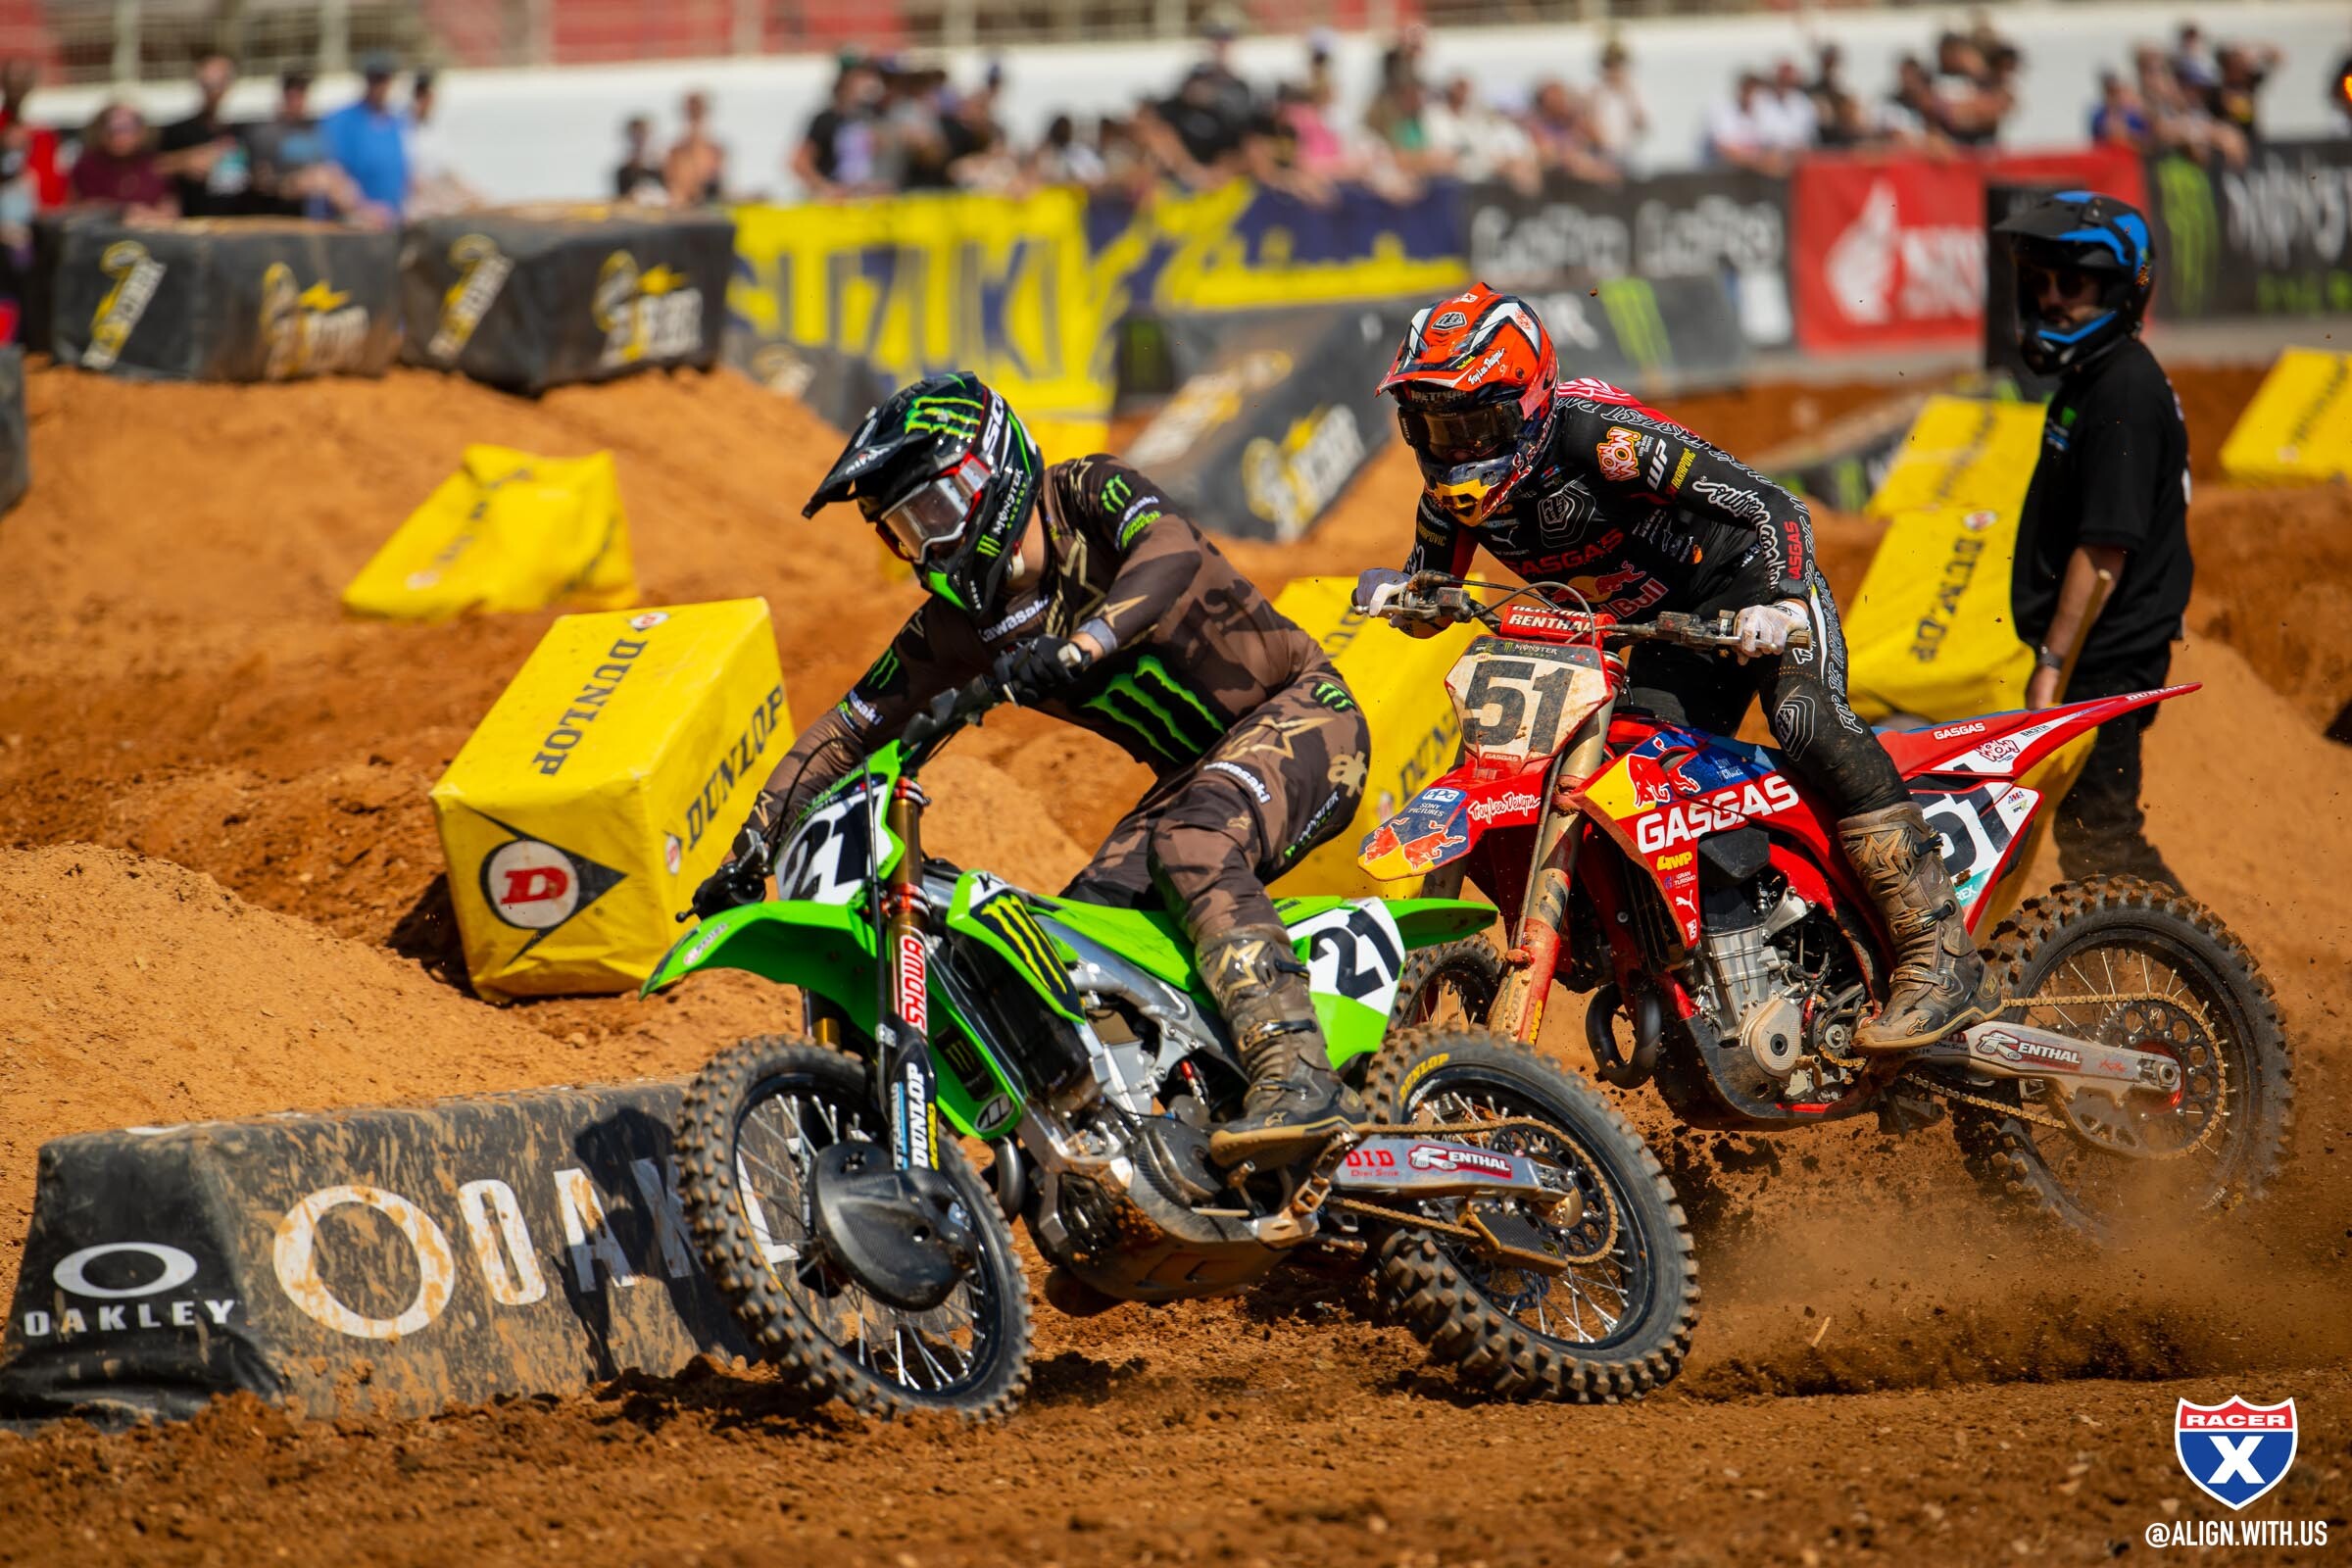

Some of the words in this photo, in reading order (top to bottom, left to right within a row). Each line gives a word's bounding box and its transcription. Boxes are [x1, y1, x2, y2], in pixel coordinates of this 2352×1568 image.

[993, 467, 1024, 535] MONSTER
[1784, 520, 1803, 580] ASGAS
[1508, 613, 1596, 633] RENTHAL
[1515, 644, 1558, 656] MONSTER
[532, 637, 648, 776] DUNLOP
[1462, 660, 1575, 755] 51
[1934, 722, 1985, 741] GASGAS
[687, 683, 788, 851] DUNLOP
[1485, 754, 1519, 763] GASGAS
[1406, 806, 1446, 817] PICTURES
[1419, 802, 1442, 811] SONY
[1423, 789, 1459, 802] PPG
[1468, 799, 1494, 824] Troy
[1501, 791, 1542, 817] Designs
[1636, 774, 1800, 855] GASGAS
[783, 794, 880, 901] 21
[501, 866, 568, 905] D
[1309, 907, 1403, 1001] 21
[901, 934, 928, 1035] SHOWA
[1398, 1053, 1450, 1108] DUNLOP
[906, 1061, 930, 1169] DUNLOP
[1408, 1146, 1511, 1172] RENTHAL
[24, 1298, 235, 1338] OAKLEY
